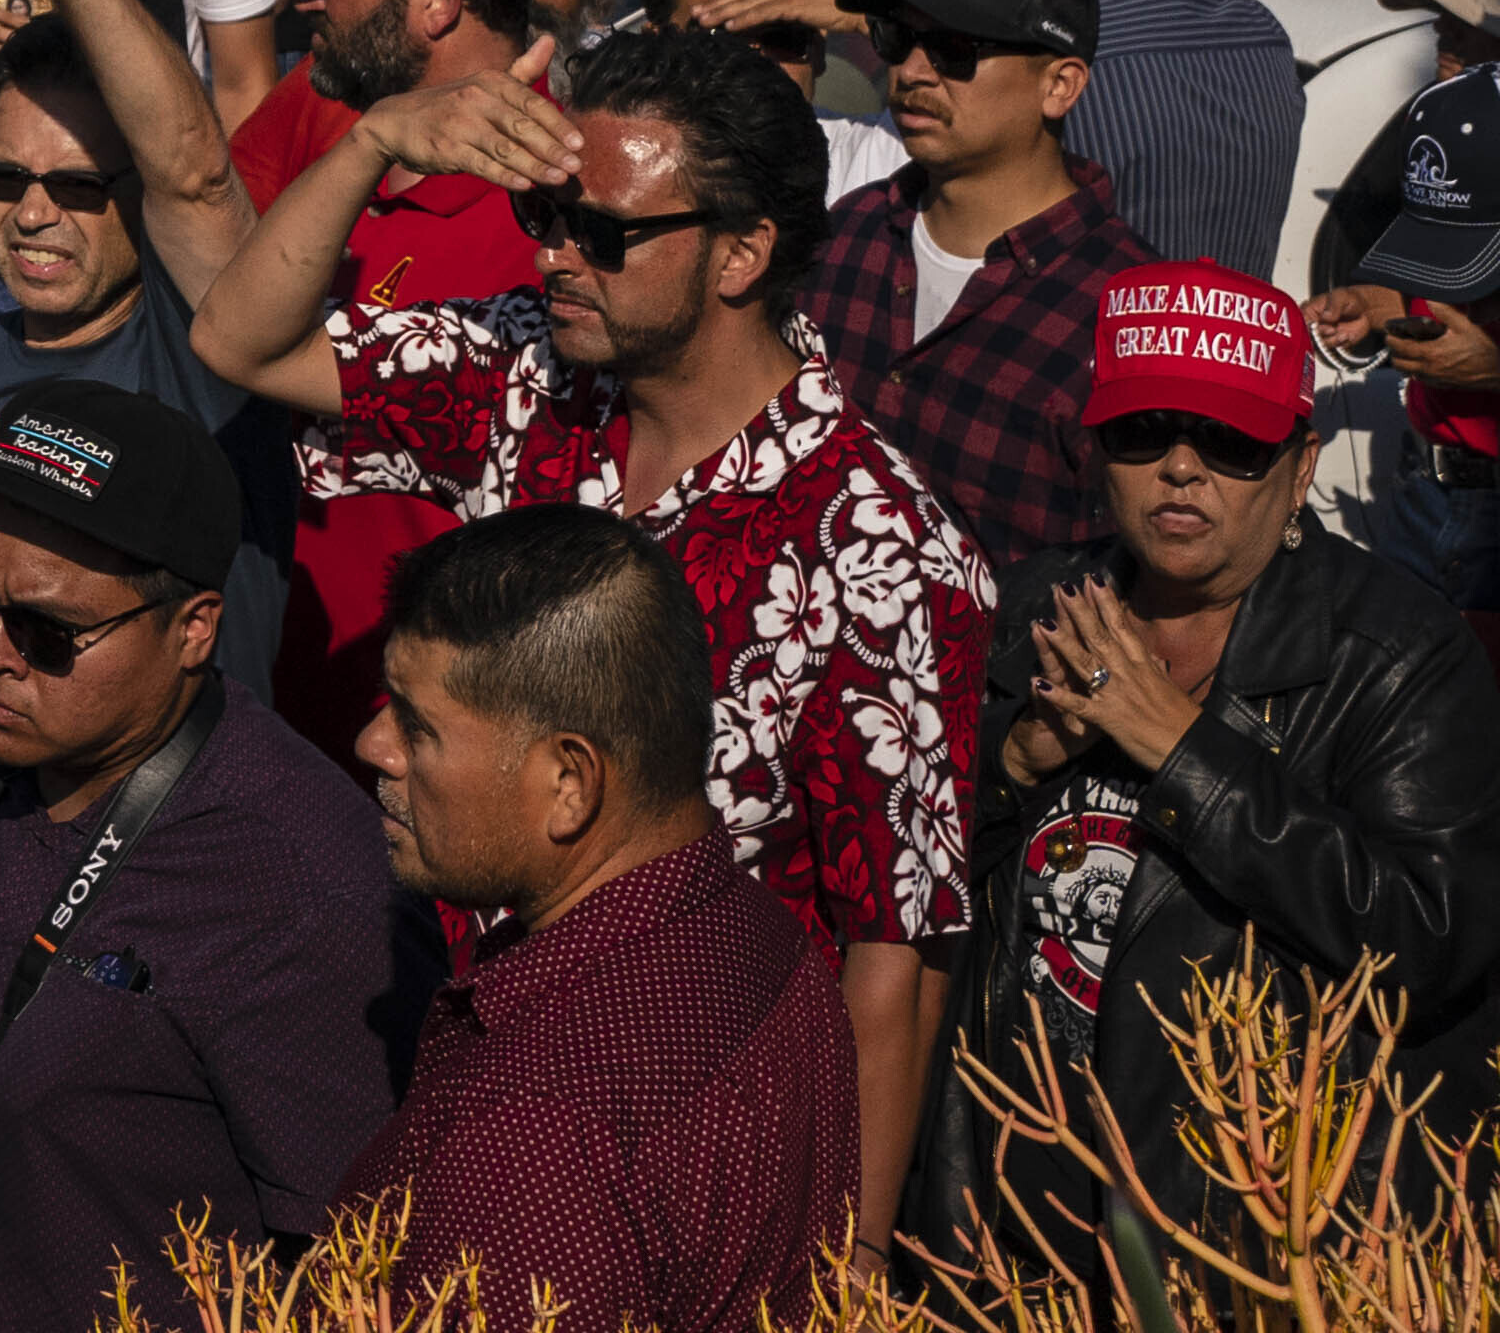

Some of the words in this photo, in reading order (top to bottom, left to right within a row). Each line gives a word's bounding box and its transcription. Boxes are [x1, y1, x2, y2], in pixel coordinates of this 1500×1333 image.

[1105, 284, 1170, 319] MAKE
[1175, 284, 1292, 337] AMERICA
[1114, 325, 1191, 363] GREAT
[1194, 335, 1275, 375] AGAIN
[13, 413, 114, 464] American
[13, 433, 88, 478] Racing
[39, 463, 93, 498] Wheels
[51, 823, 123, 930] SONY
